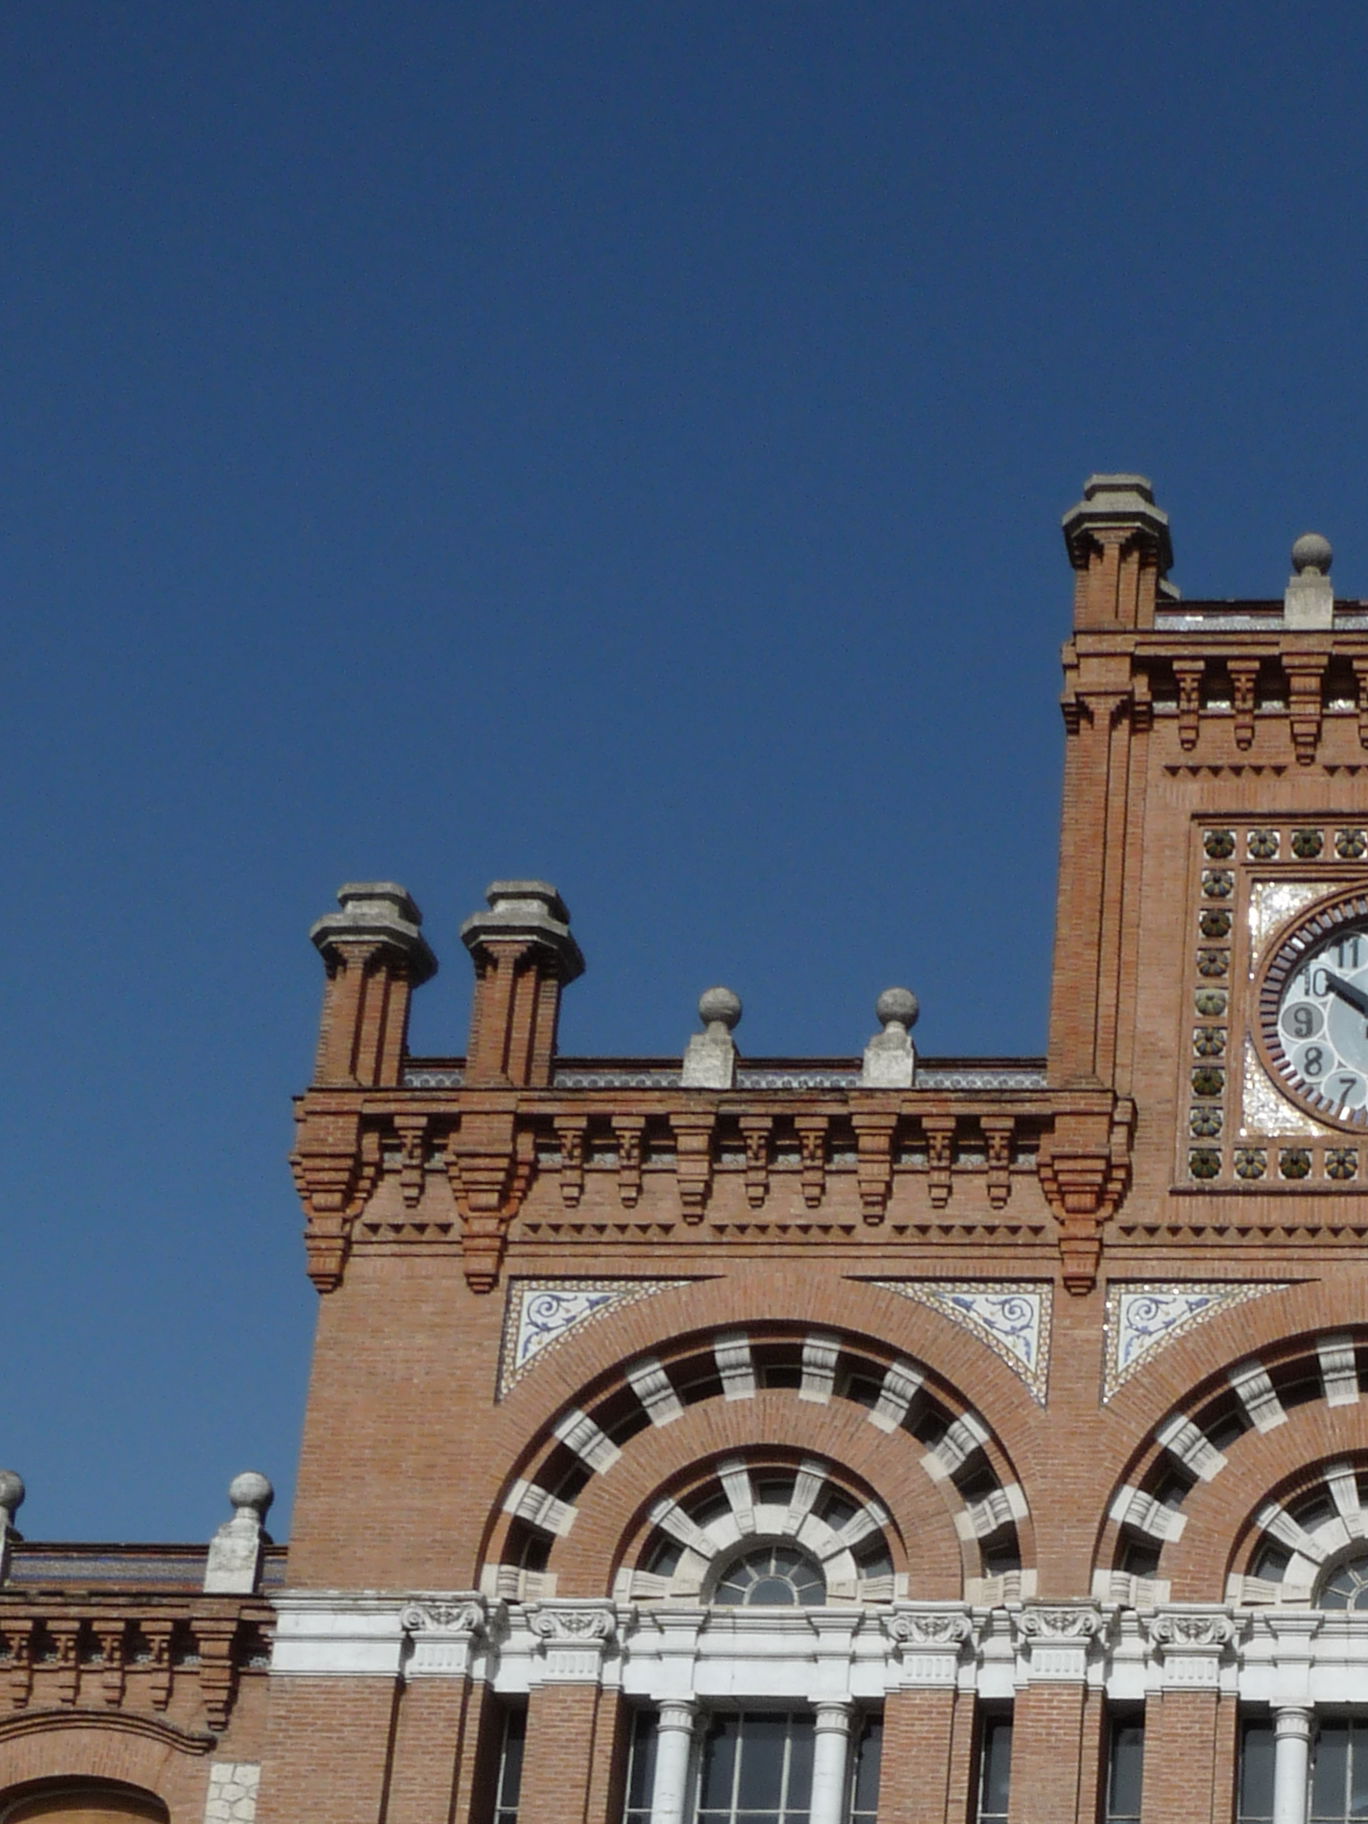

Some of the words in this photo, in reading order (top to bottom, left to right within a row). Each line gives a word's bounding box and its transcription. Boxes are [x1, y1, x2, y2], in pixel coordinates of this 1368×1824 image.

[1337, 938, 1359, 969] 11
[1304, 964, 1330, 998] 10
[1294, 1007, 1313, 1037] 9
[1304, 1046, 1323, 1076] 8
[1338, 1077, 1358, 1108] 7
